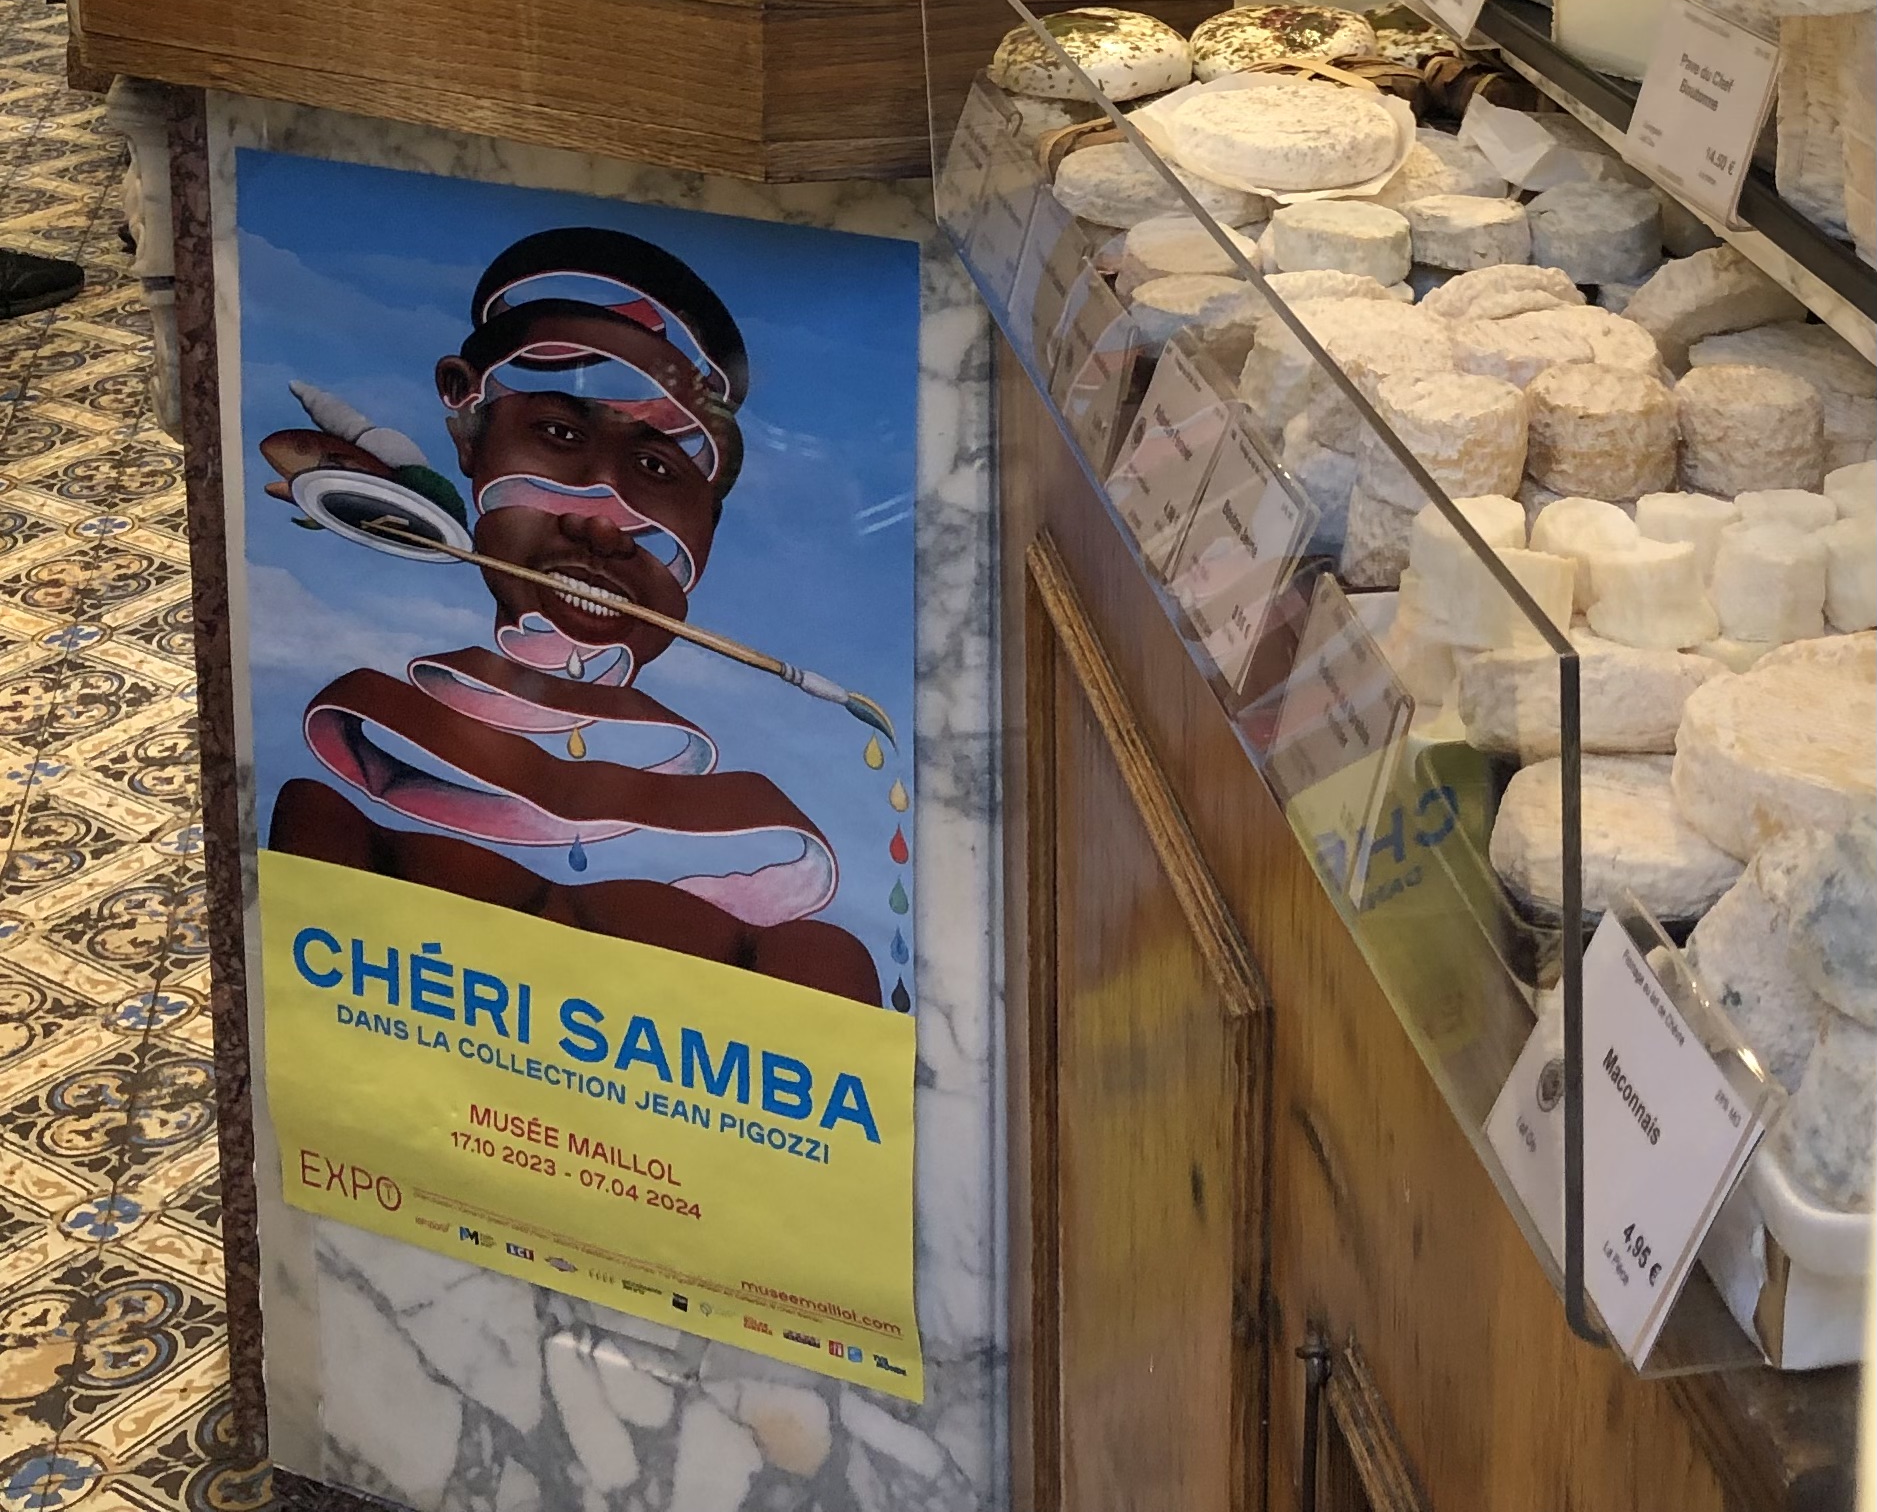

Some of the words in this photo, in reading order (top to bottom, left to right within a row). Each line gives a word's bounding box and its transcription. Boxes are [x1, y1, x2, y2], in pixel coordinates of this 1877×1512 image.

[292, 927, 531, 1044] CHÉRI
[558, 998, 881, 1144] SAMBA
[337, 1004, 409, 1040] DANS
[417, 1025, 450, 1052] LA
[458, 1038, 626, 1104] COLLECTION
[635, 1091, 711, 1129] JEAN
[719, 1113, 829, 1165] PIGOZZI
[1603, 1047, 1661, 1145] Maconnais
[451, 1131, 495, 1157] 17.10
[502, 1146, 556, 1177] 2023
[580, 1169, 639, 1201] 07.04
[646, 1190, 702, 1220] 2024
[470, 1104, 559, 1149] MUSÉE
[568, 1133, 681, 1186] MAILLOL
[1623, 1223, 1652, 1269] 4,95
[1649, 1262, 1662, 1288] €
[741, 1281, 902, 1335] museemaillol.com
